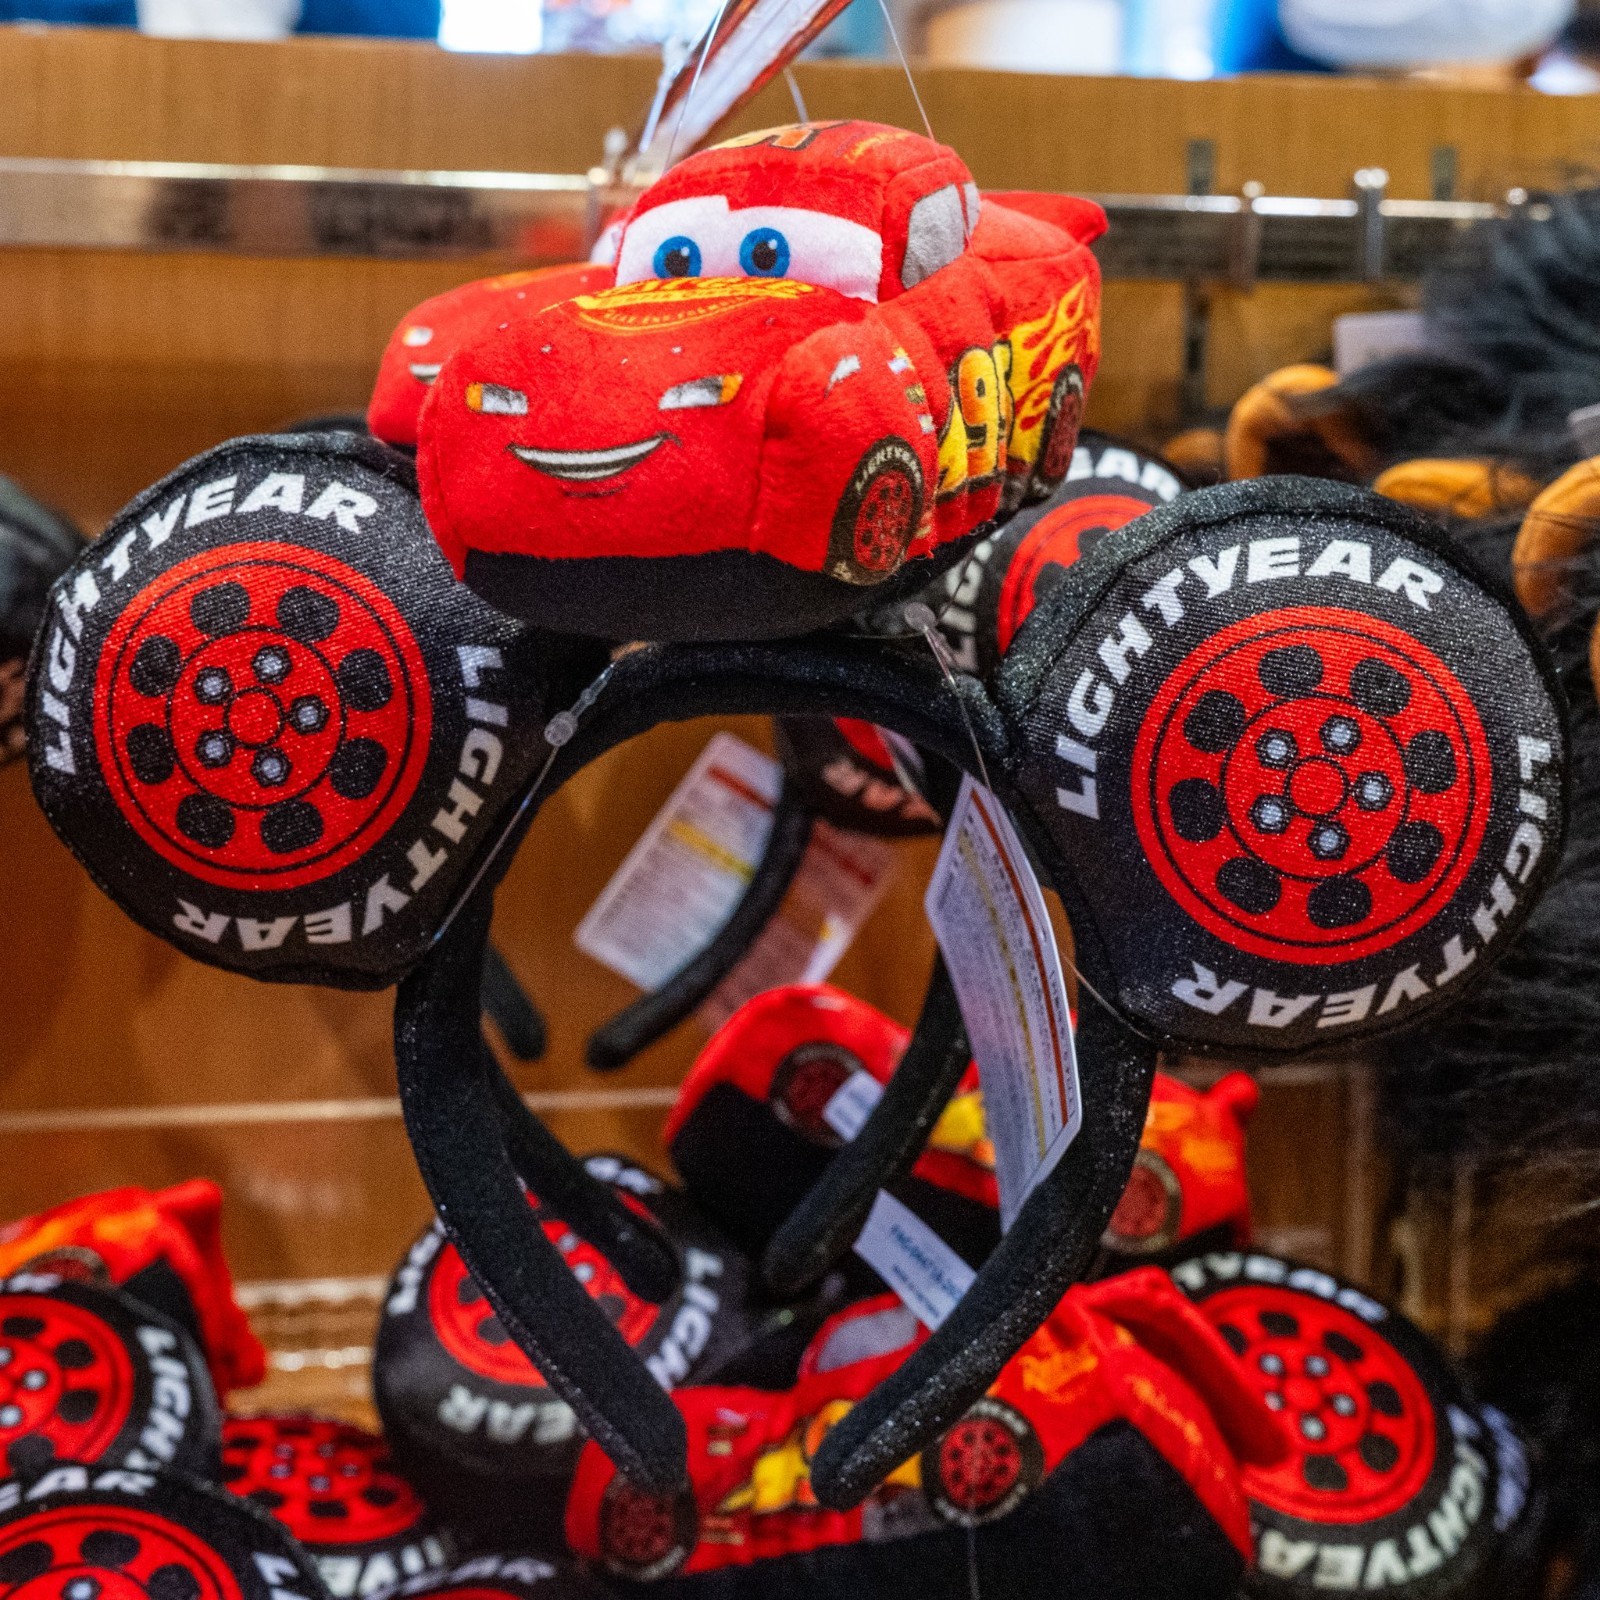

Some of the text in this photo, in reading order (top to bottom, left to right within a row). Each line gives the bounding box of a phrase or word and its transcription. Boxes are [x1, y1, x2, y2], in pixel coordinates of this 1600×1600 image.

[43, 472, 378, 774] LIGHTYEAR
[1055, 537, 1443, 820] LIGHTYEAR
[173, 645, 508, 951] LIGHTYEAR
[1171, 735, 1551, 1028] LIGHTYEAR
[1256, 1404, 1488, 1590] LIGHTYEA
